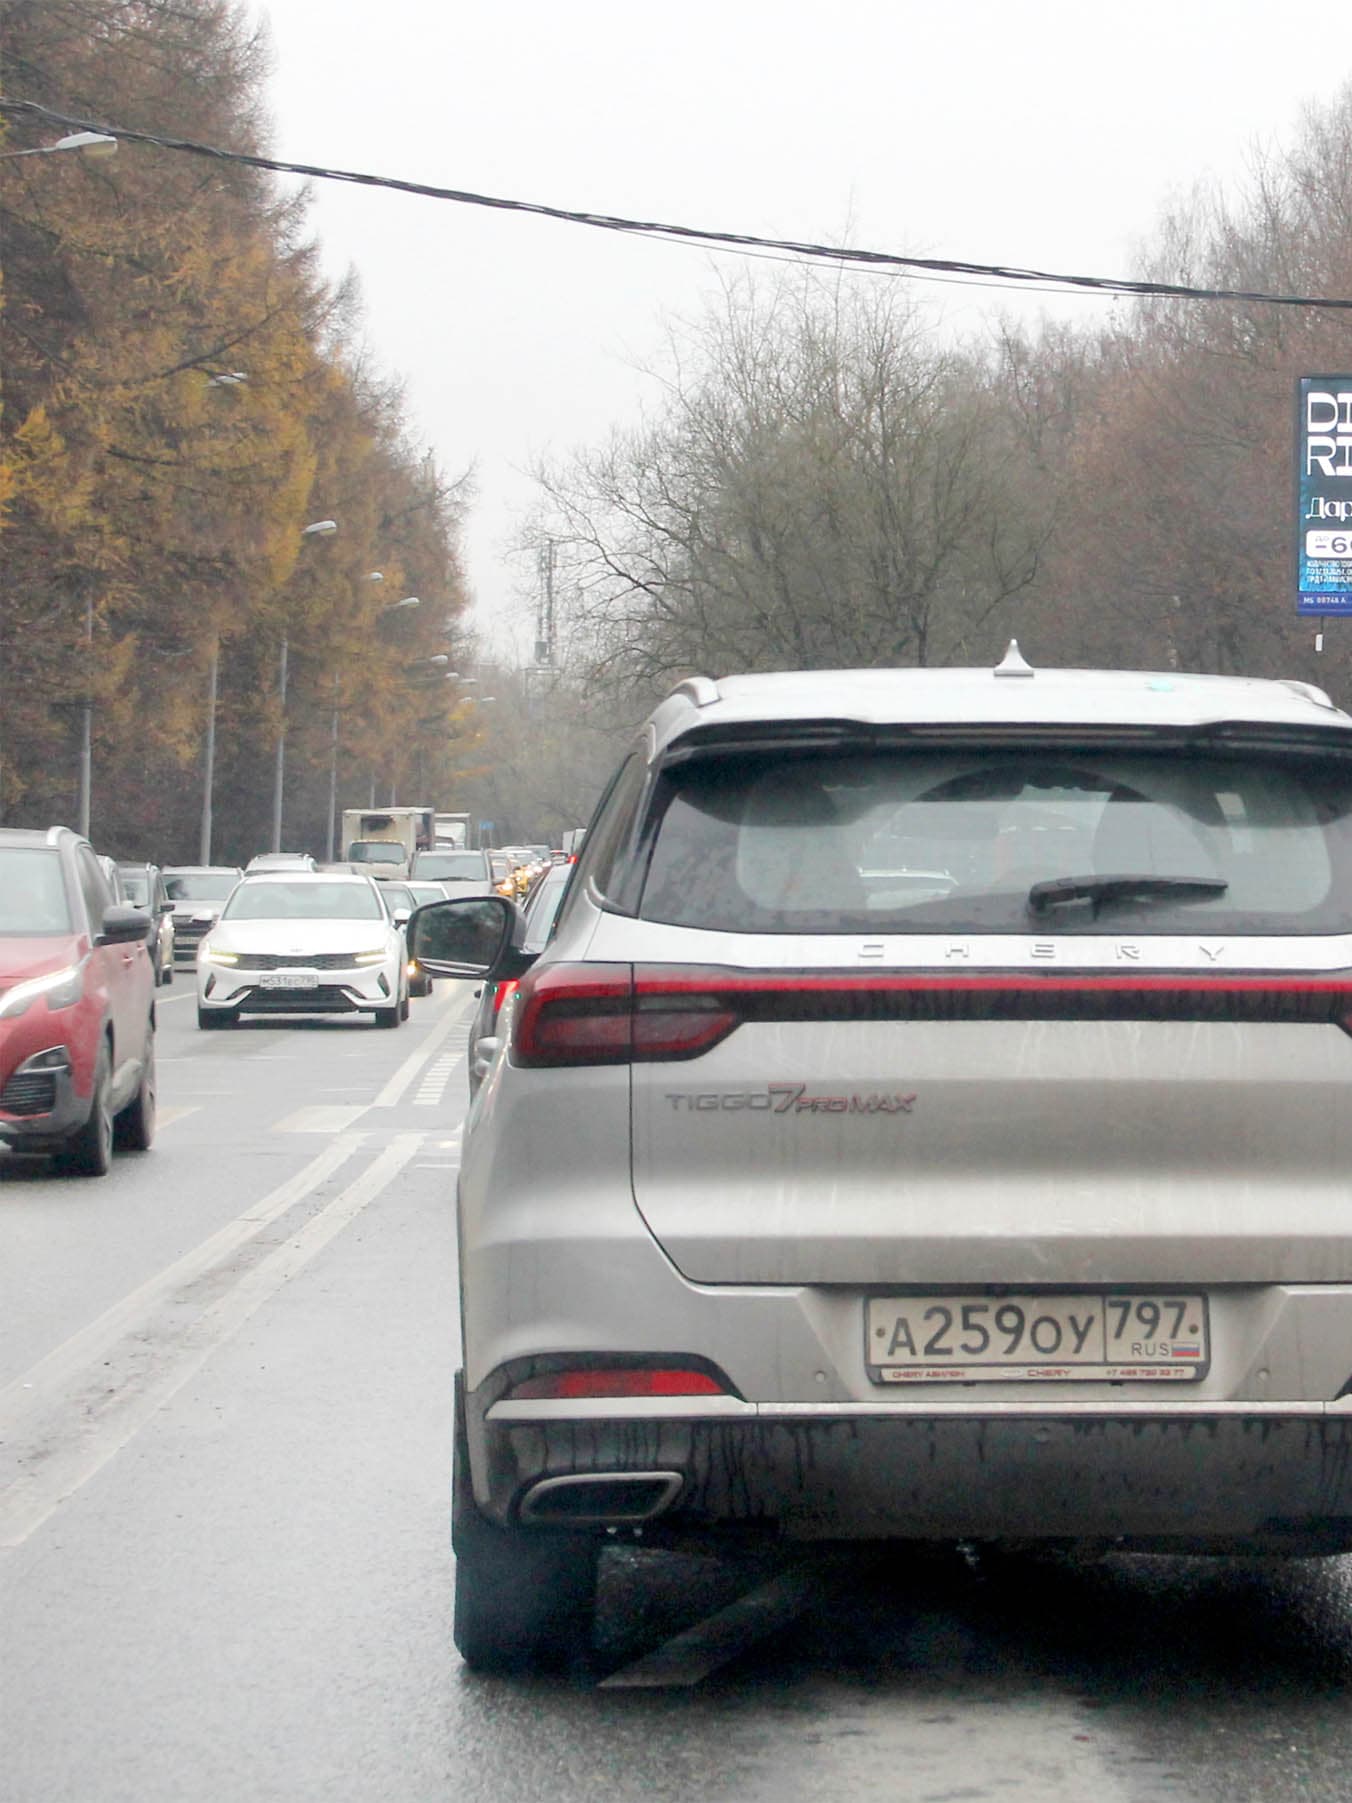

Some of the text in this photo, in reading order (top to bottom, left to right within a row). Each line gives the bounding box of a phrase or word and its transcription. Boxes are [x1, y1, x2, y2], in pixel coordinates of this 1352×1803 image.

[857, 943, 1224, 962] CHERY
[1106, 1301, 1188, 1340] 797
[1131, 1343, 1171, 1357] RUS
[1027, 1368, 1071, 1378] CHERY
